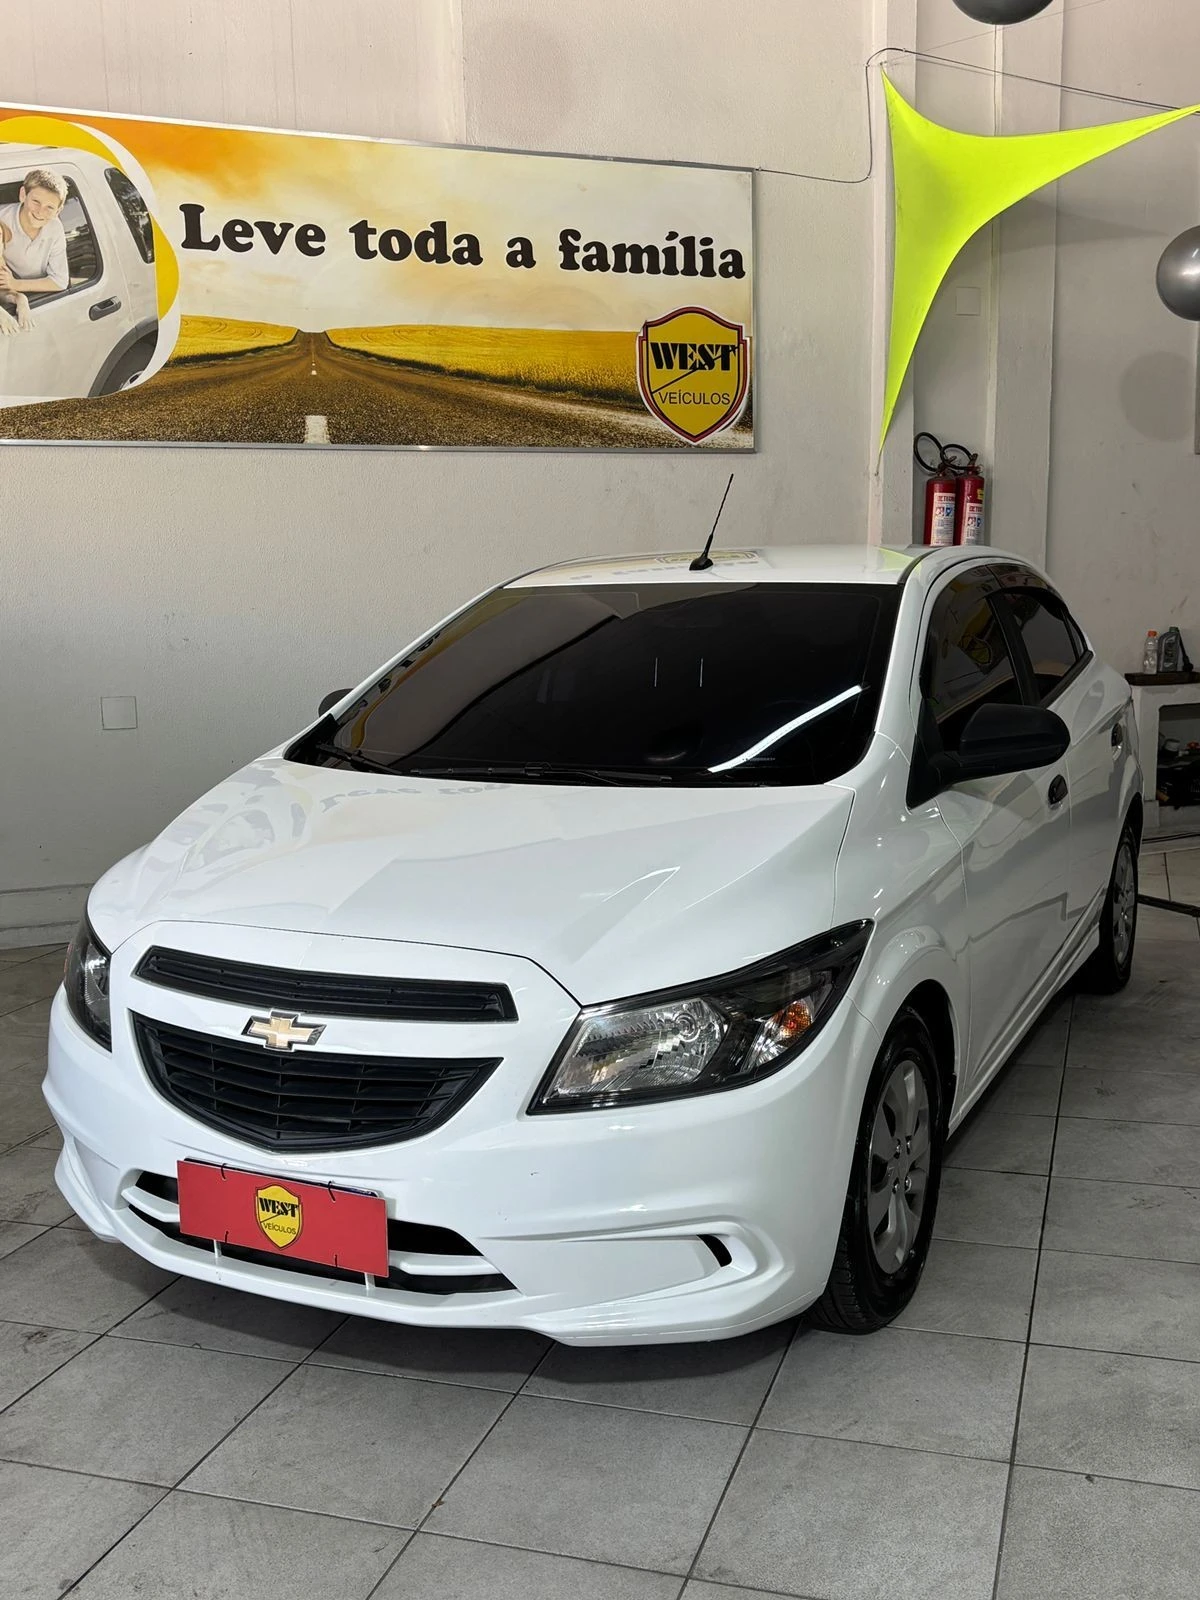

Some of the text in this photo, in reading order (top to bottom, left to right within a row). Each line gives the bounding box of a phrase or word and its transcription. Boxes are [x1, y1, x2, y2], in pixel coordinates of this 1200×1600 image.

[179, 203, 746, 280] Leve toda a família
[649, 341, 737, 371] WEST
[658, 389, 731, 405] VEÍCULOS
[259, 1198, 299, 1218] WEST
[263, 1222, 297, 1235] VEÍCULOS
